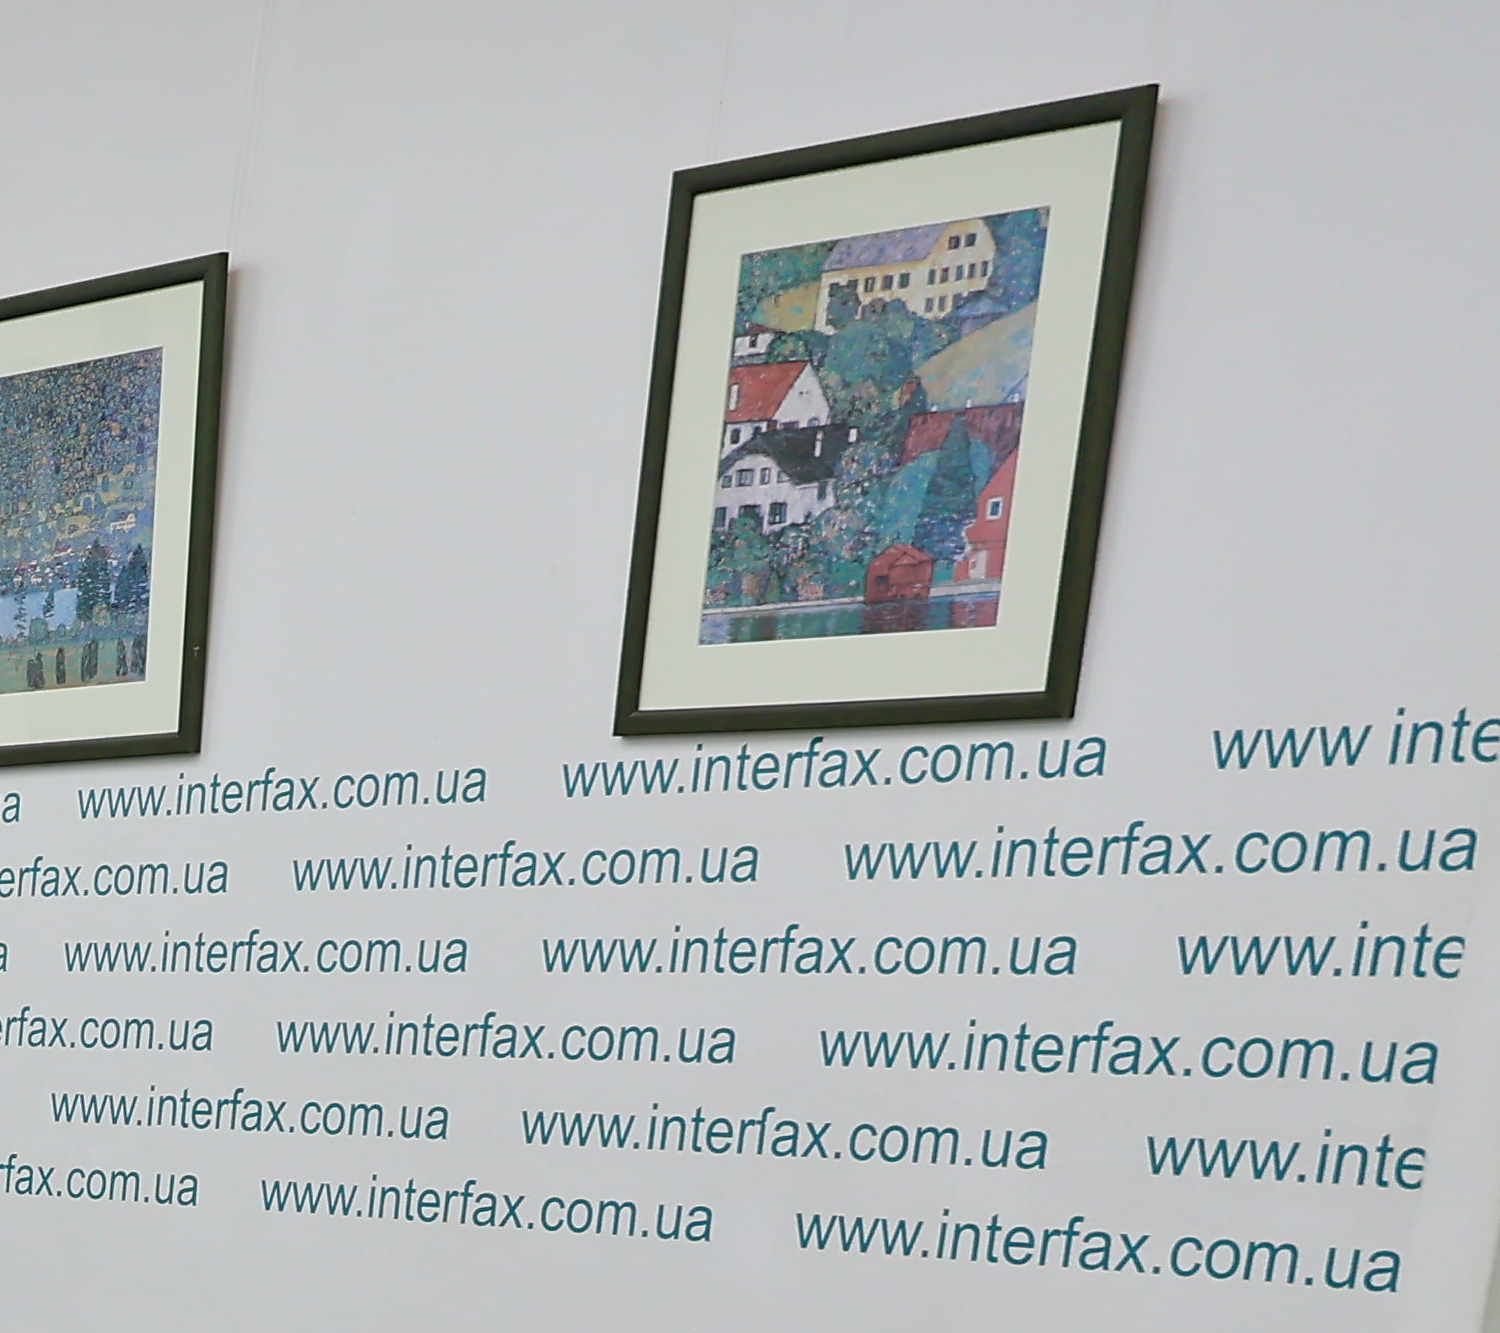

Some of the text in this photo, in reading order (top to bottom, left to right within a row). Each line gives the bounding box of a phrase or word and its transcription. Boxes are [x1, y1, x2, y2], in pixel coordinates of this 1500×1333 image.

[78, 767, 486, 819] www.interfax.com.ua
[562, 737, 1107, 798] www.interfax.com.ua
[292, 840, 759, 891] www.interfax.com.ua
[844, 820, 1478, 880] www.interfax.com.ua
[65, 929, 468, 973] www.interfax.com.ua
[542, 924, 1077, 976] www.interfax.com.ua
[277, 1010, 736, 1064] www.interfax.com.ua
[820, 1020, 1439, 1085] www.interfax.com.ua
[51, 1085, 449, 1140] www.interfax.com.ua
[522, 1103, 1048, 1170] www.interfax.com.ua
[261, 1174, 713, 1242] www.interfax.com.ua
[796, 1208, 1401, 1293] www.interfax.com.ua
